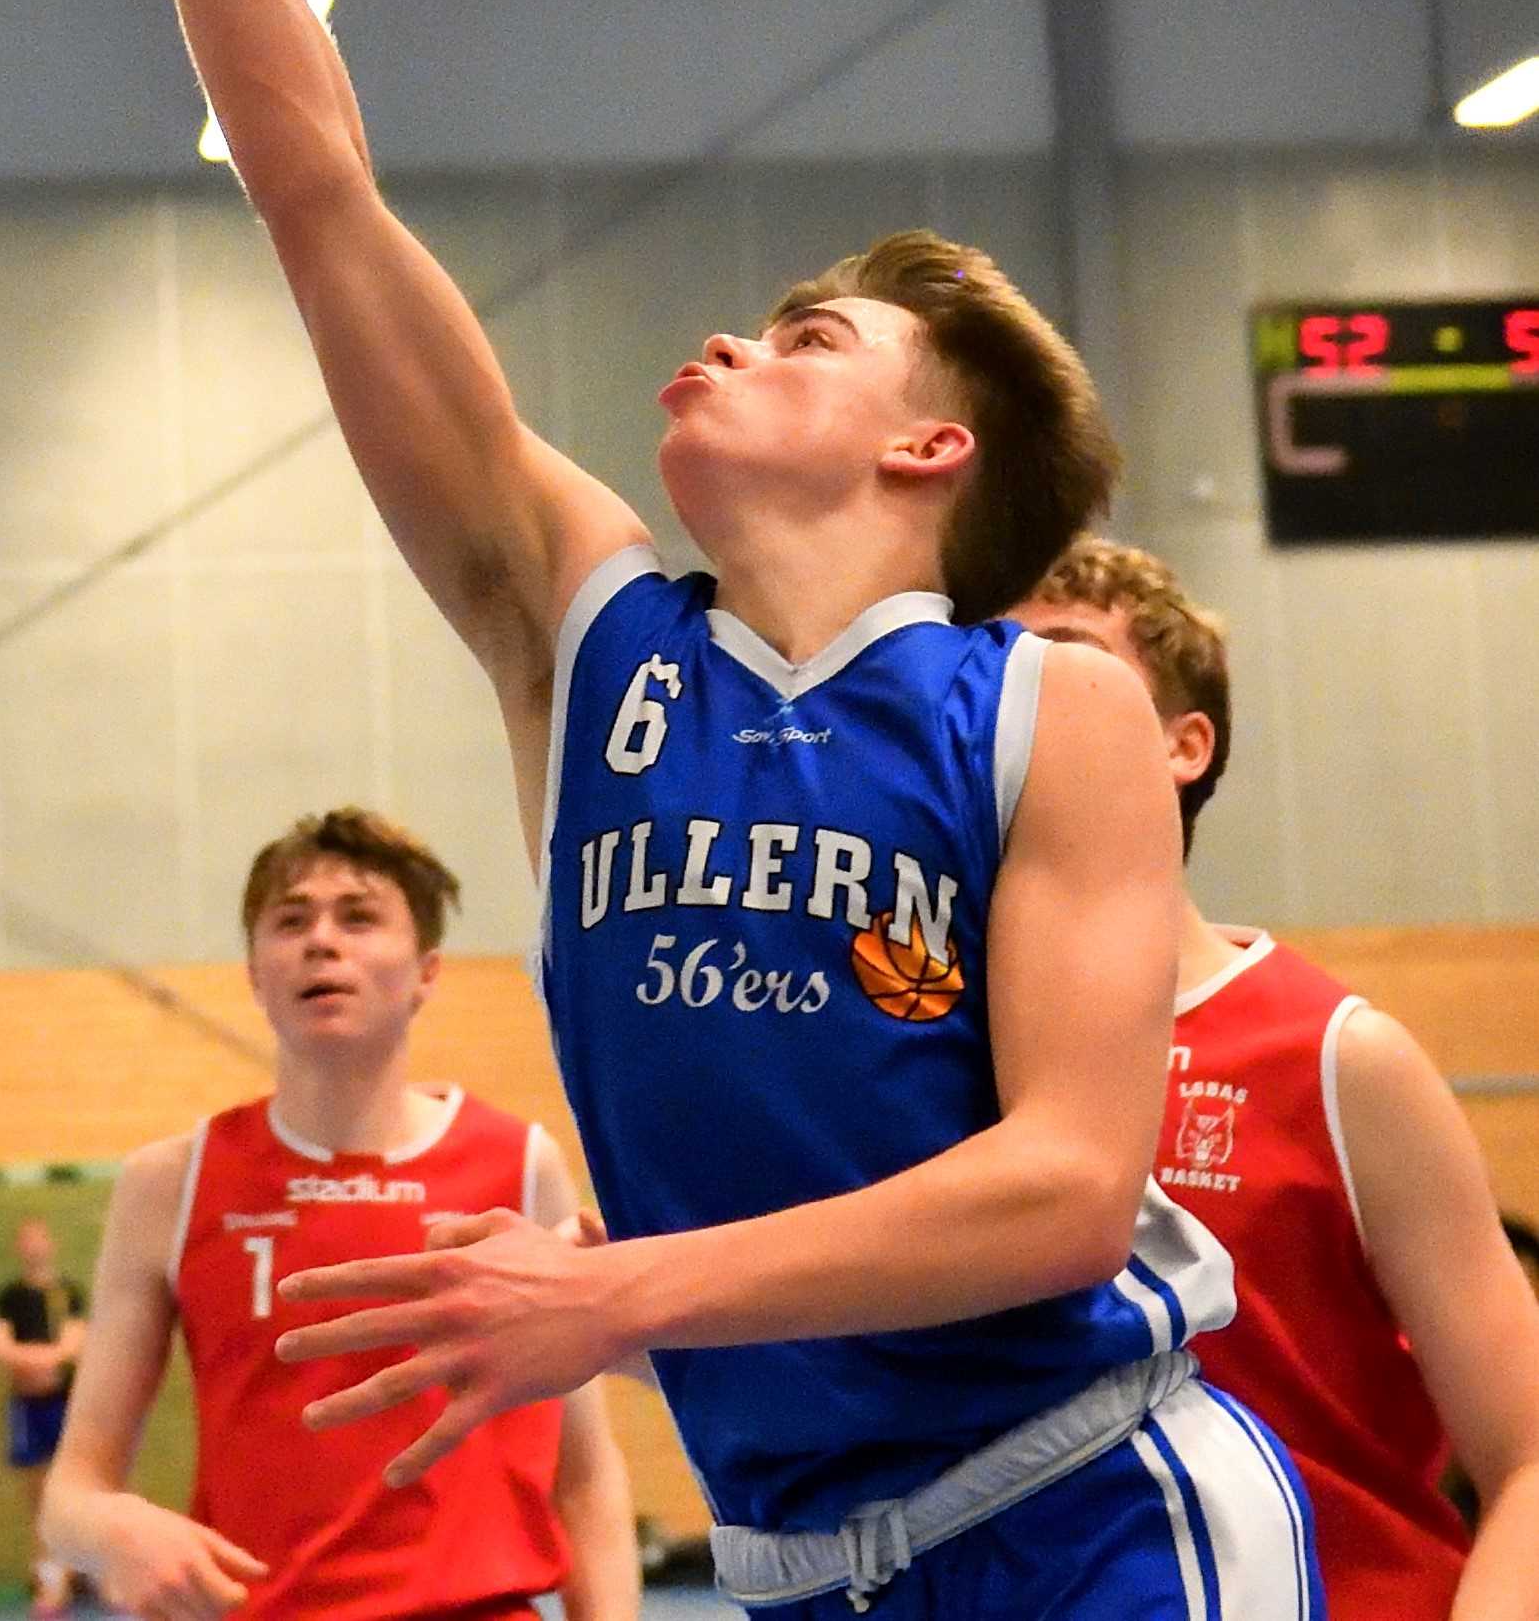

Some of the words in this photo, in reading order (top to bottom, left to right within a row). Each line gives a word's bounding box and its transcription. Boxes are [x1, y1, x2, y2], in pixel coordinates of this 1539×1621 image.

[605, 653, 682, 774] 6
[581, 820, 958, 966] ULLERN
[1160, 1167, 1241, 1191] BASKET
